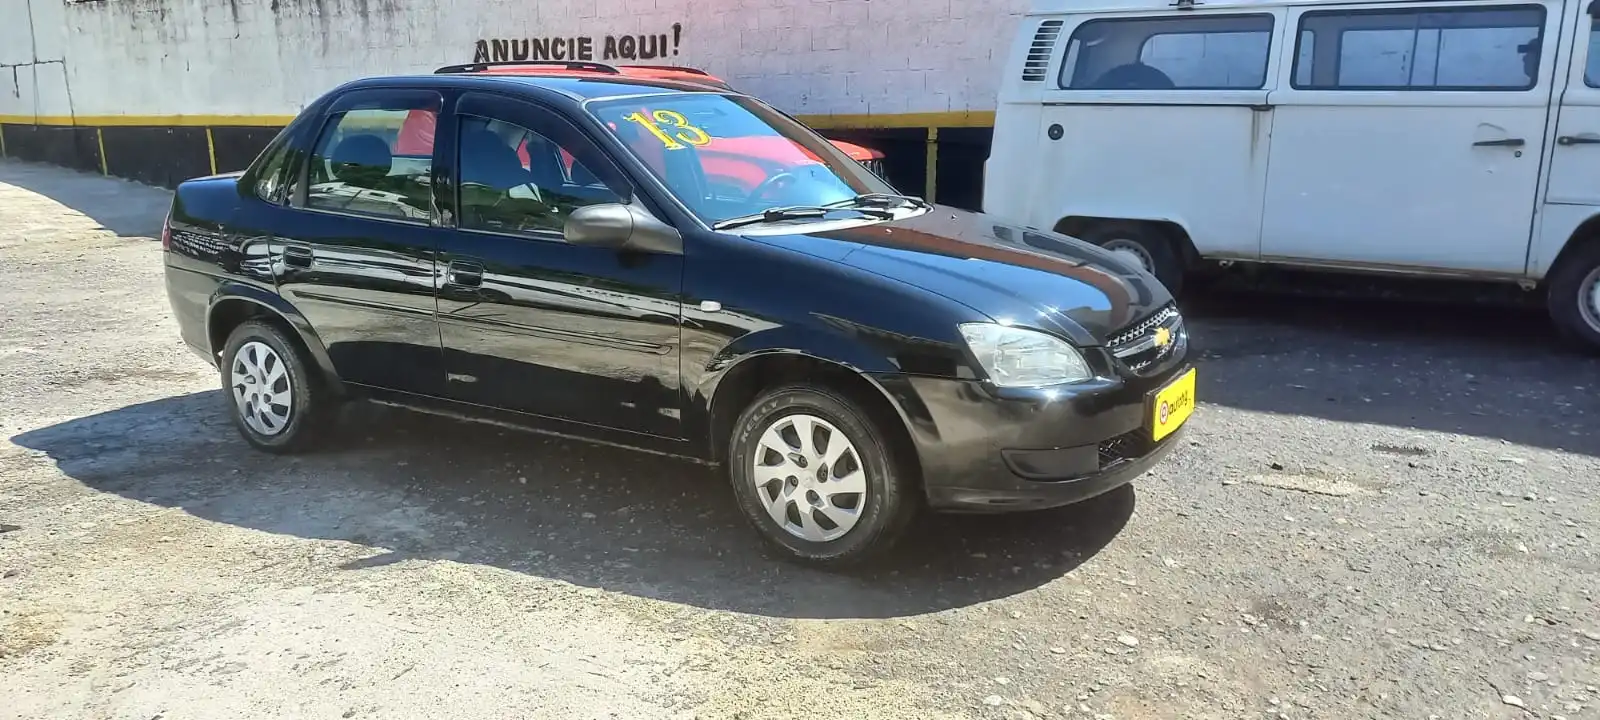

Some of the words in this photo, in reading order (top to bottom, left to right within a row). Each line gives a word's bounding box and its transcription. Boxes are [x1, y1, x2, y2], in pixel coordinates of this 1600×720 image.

[473, 37, 592, 63] ANUNCIE
[603, 22, 682, 60] AQUI!
[622, 109, 712, 151] 13
[741, 400, 778, 443] KELLY
